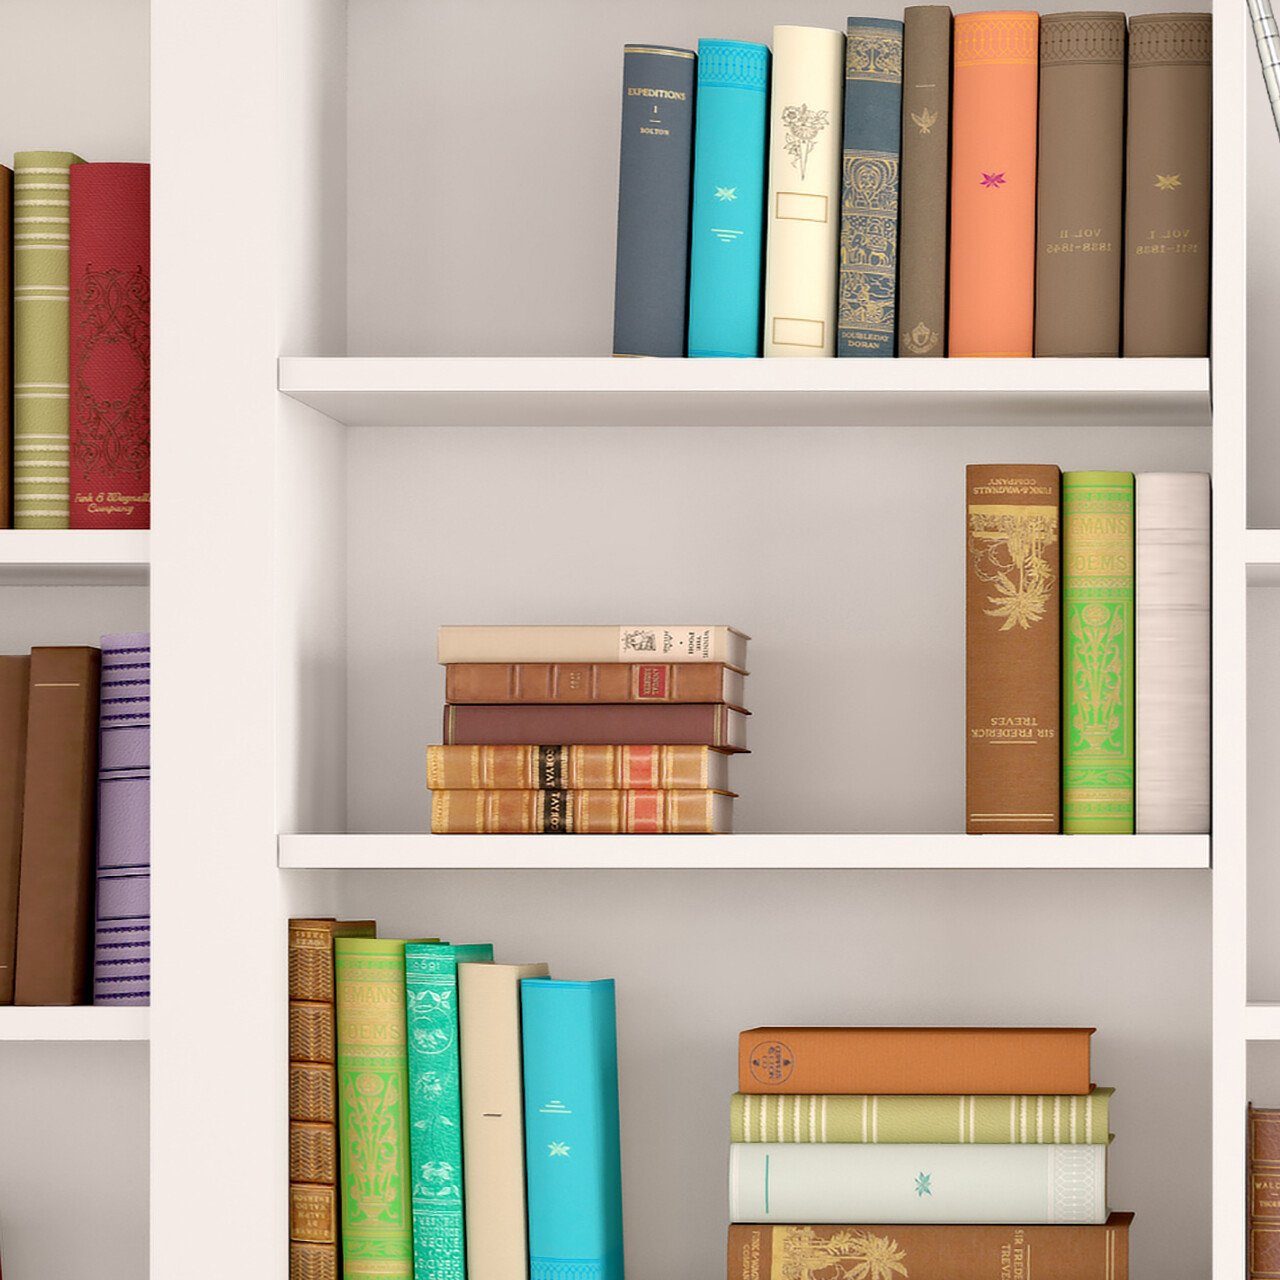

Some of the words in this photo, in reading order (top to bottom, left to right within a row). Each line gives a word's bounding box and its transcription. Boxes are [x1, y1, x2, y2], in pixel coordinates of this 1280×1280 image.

[626, 87, 686, 101] EXPEDITIONS
[990, 717, 1038, 726] TREVES
[971, 728, 1033, 738] FREDERICK
[1036, 728, 1055, 738] SIR
[1000, 1243, 1012, 1280] TREVE
